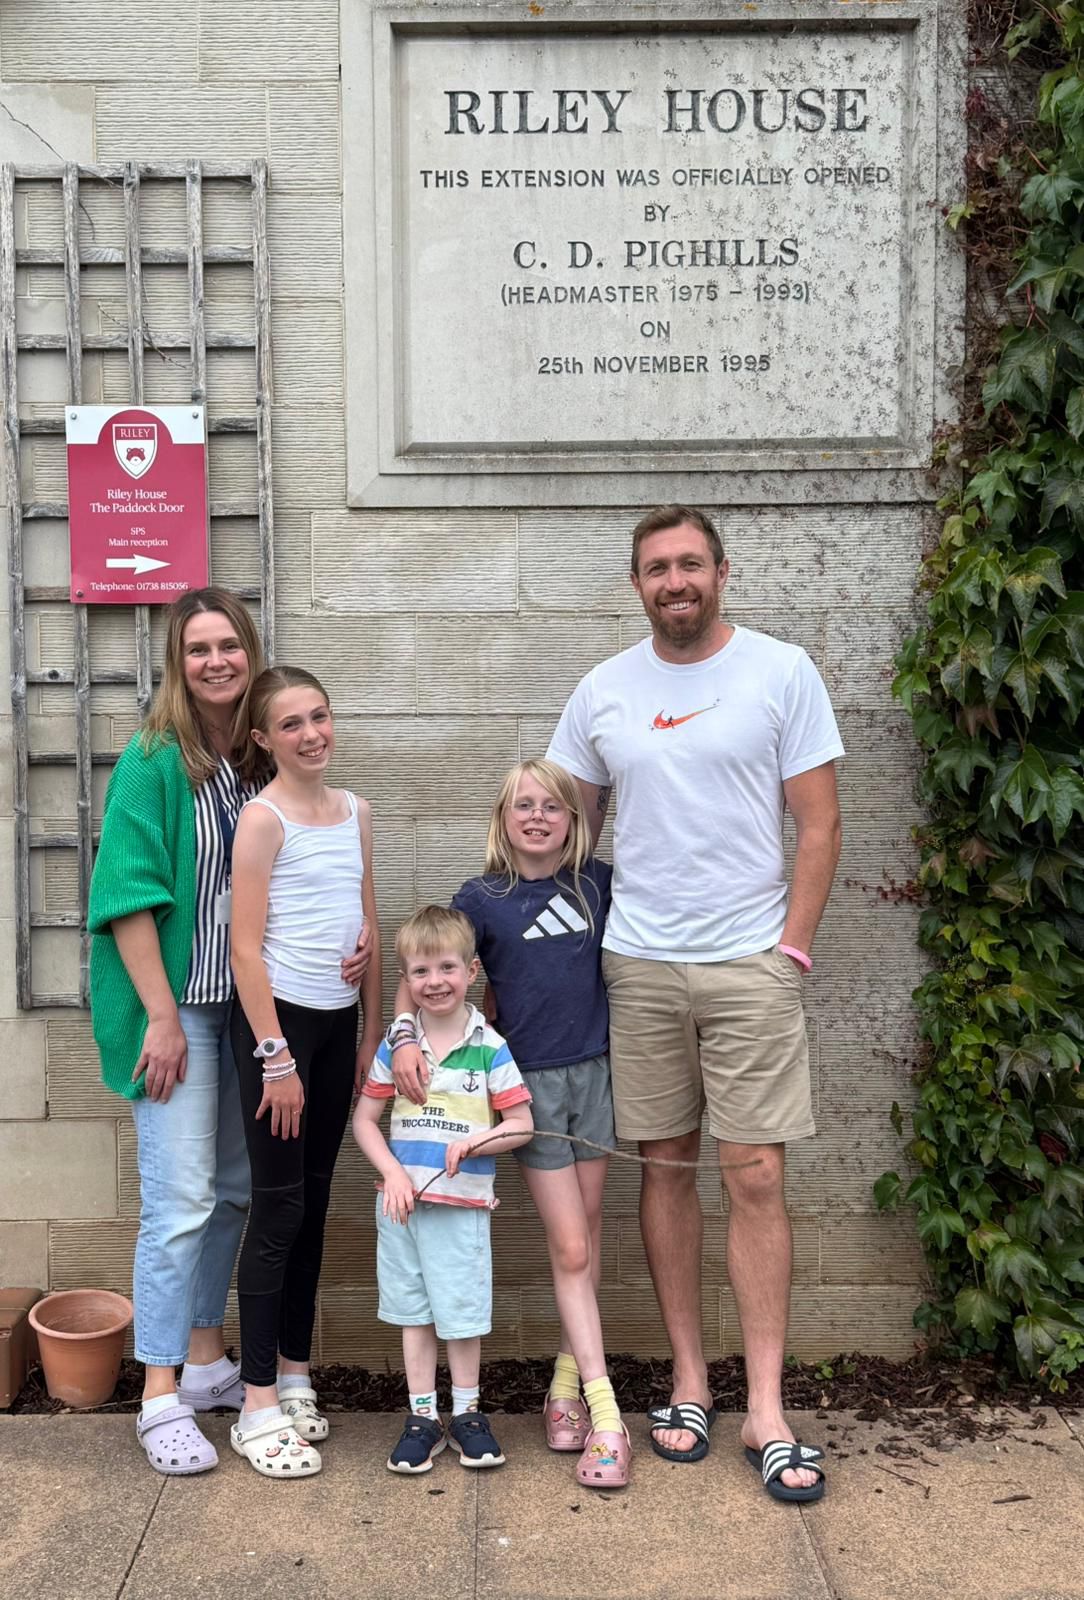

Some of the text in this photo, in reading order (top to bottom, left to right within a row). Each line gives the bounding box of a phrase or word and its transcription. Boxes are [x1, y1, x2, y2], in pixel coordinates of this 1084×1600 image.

[444, 87, 868, 136] RILEY HOUSE
[420, 166, 891, 188] THIS EXTENSION WAS OFFICIALLY OPENED
[644, 204, 671, 223] BY
[512, 237, 801, 270] C. D. PIGHILLS
[500, 285, 659, 307] (HEADMASTER
[669, 284, 719, 302] 1975
[753, 281, 810, 303] 1993)
[640, 320, 671, 340] ON
[537, 354, 771, 376] 25th NOVEMBER 1995
[120, 428, 151, 439] RILEY
[107, 489, 167, 501] Riley House
[90, 502, 184, 513] The Paddock Door
[130, 527, 146, 536] SPS
[108, 538, 168, 548] Main reception
[90, 581, 188, 592] Telephone: 01738 815056
[422, 1106, 445, 1116] THE
[401, 1119, 470, 1133] BUCCANEERS
